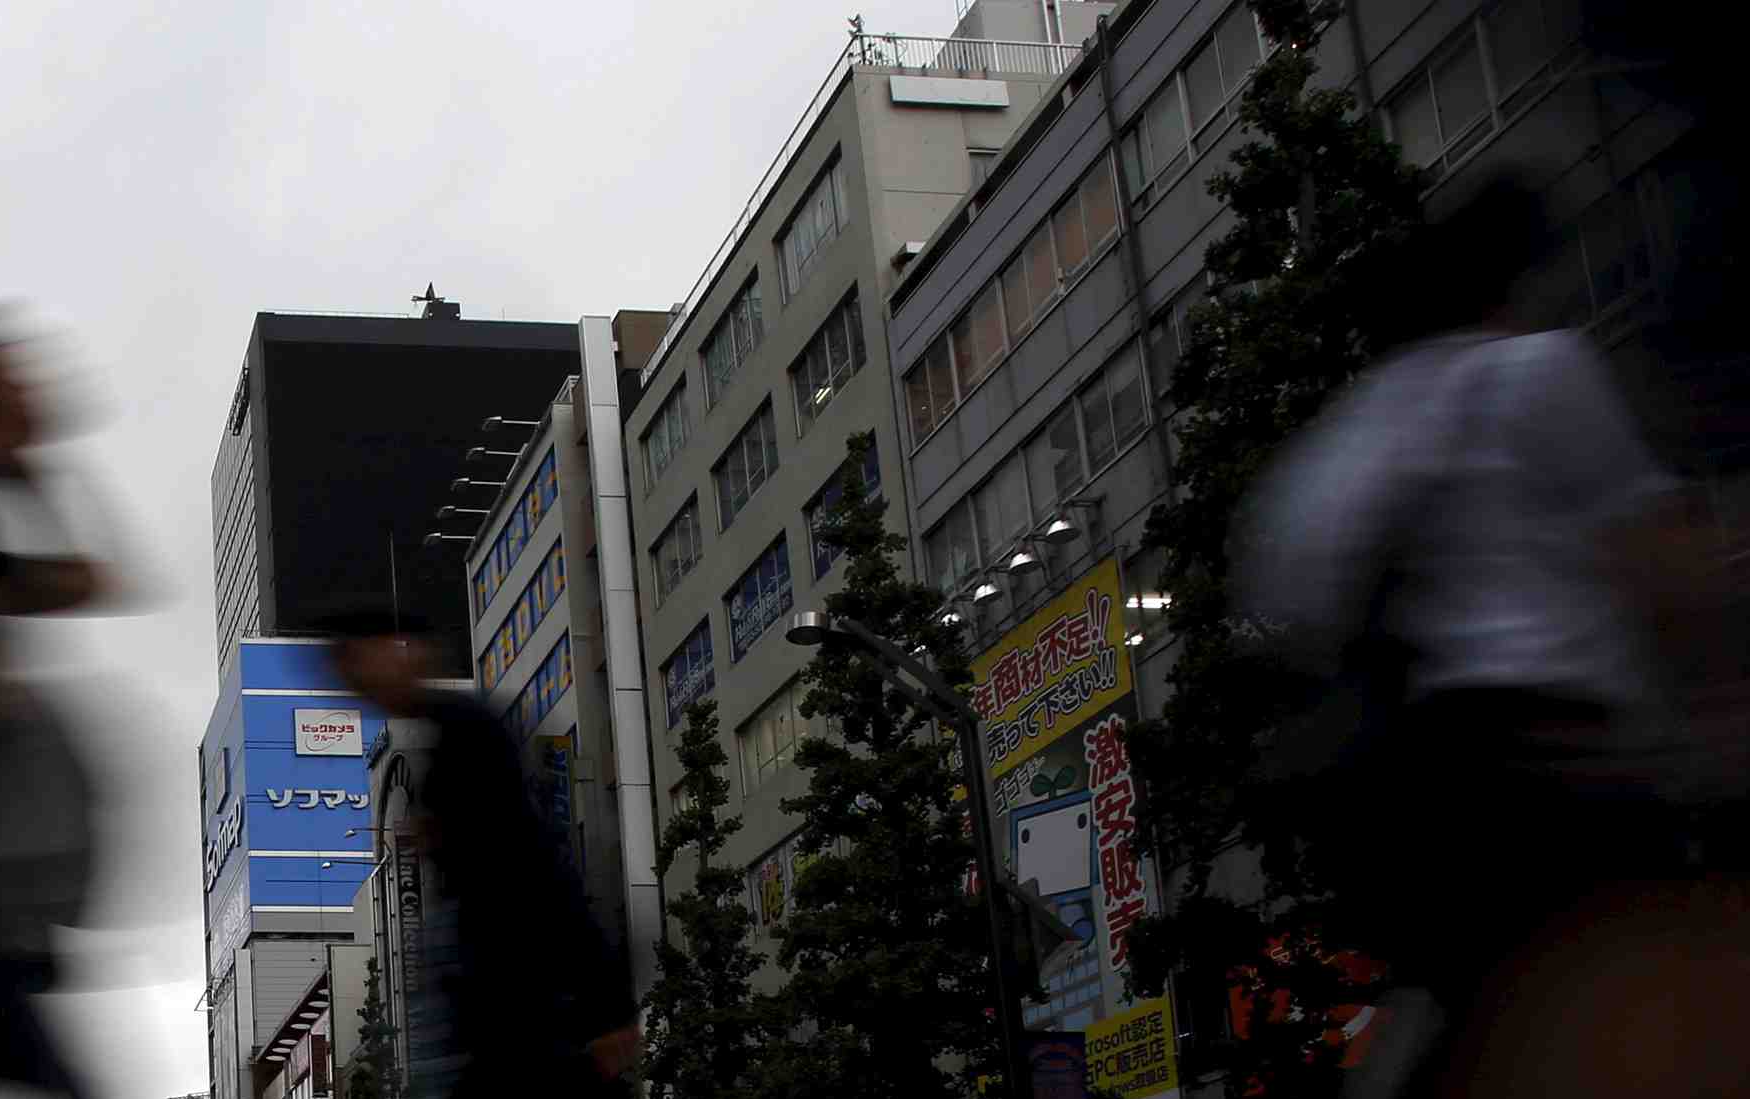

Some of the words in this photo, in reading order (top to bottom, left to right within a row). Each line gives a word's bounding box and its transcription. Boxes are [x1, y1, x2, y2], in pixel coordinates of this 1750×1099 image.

[301, 723, 355, 734] ビックカメラ
[313, 733, 345, 743] グループ
